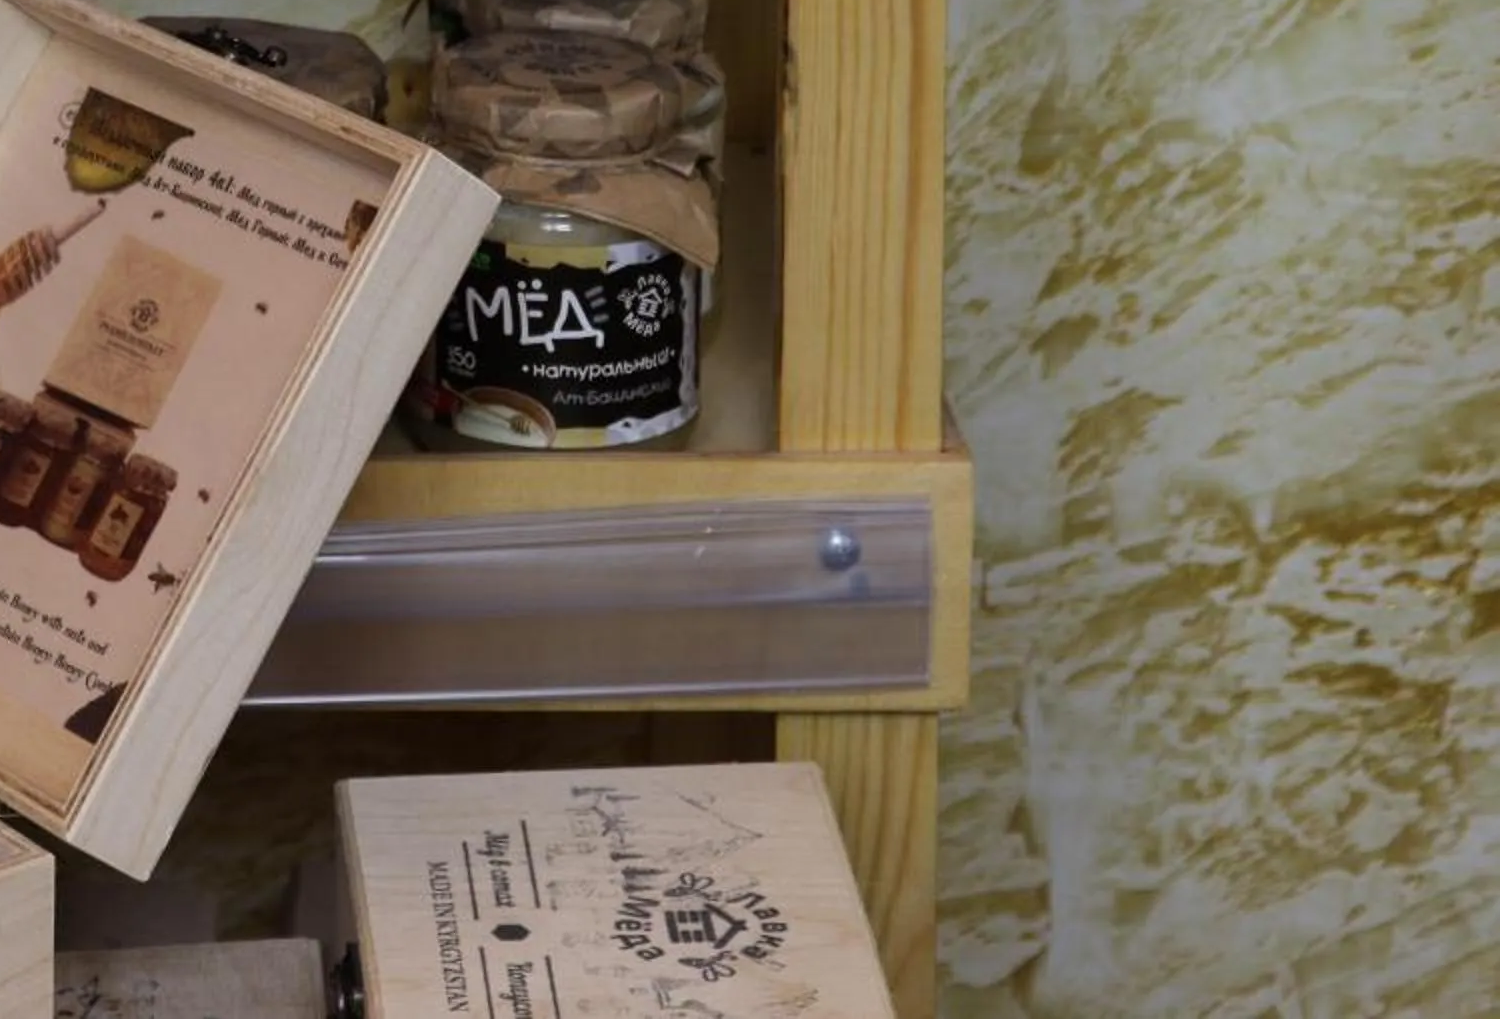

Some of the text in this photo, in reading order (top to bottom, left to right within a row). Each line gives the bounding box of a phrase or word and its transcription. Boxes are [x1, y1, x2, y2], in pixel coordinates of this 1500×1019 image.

[465, 279, 605, 353] МЁД
[427, 861, 470, 1013] MADE IN KYRGYZSTAN
[610, 895, 666, 961] Мёда
[726, 891, 788, 960] Лавка
